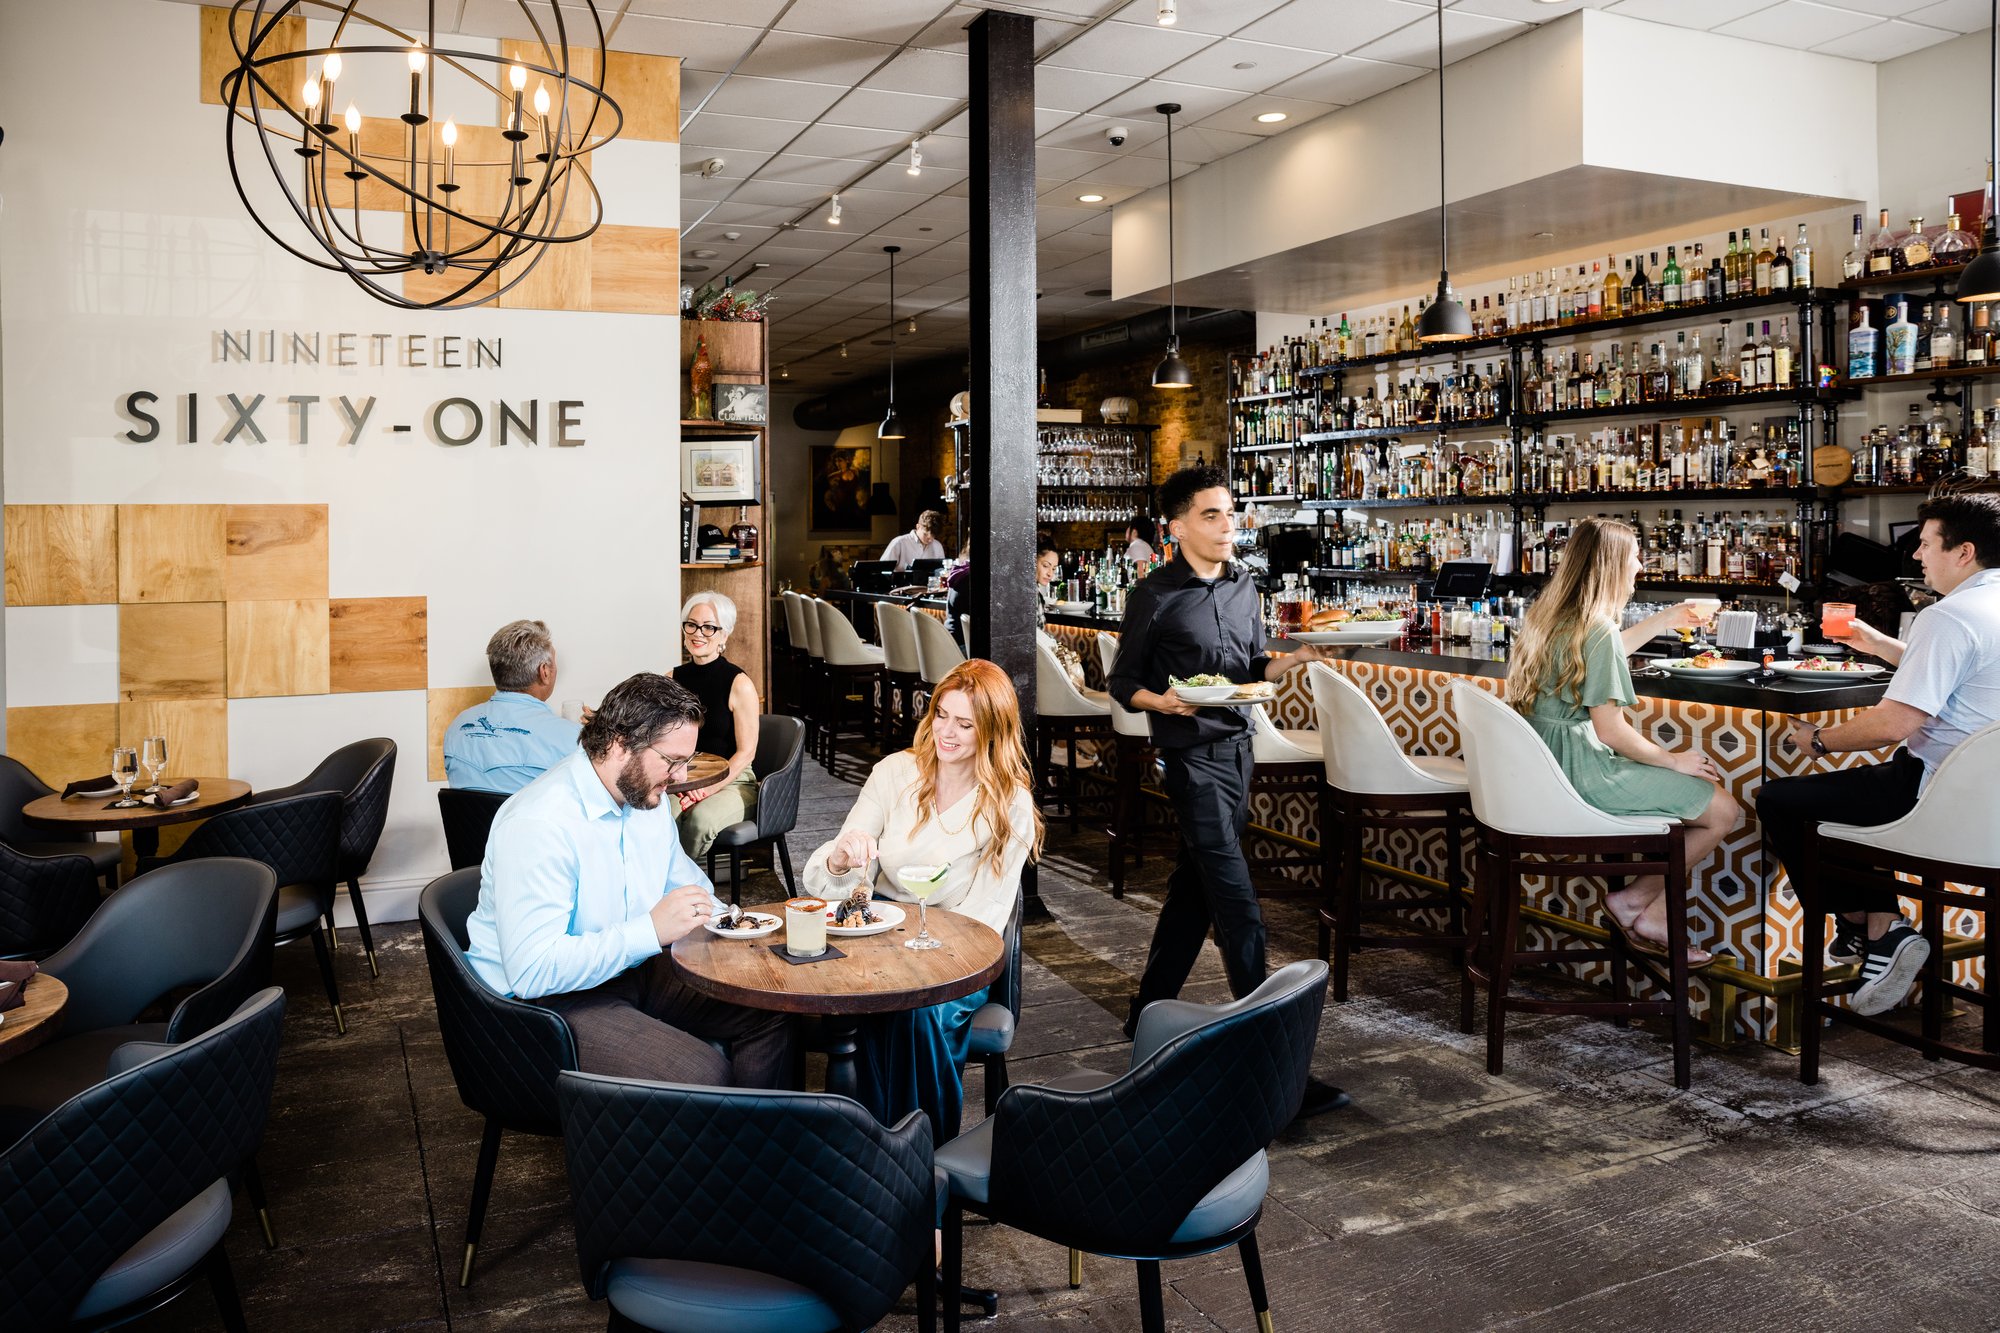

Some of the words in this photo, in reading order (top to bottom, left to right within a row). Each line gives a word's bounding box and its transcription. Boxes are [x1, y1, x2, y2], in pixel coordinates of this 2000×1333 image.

[222, 328, 502, 369] NINETEEN
[125, 390, 586, 447] SIXTY-ONE
[744, 413, 766, 421] THEN
